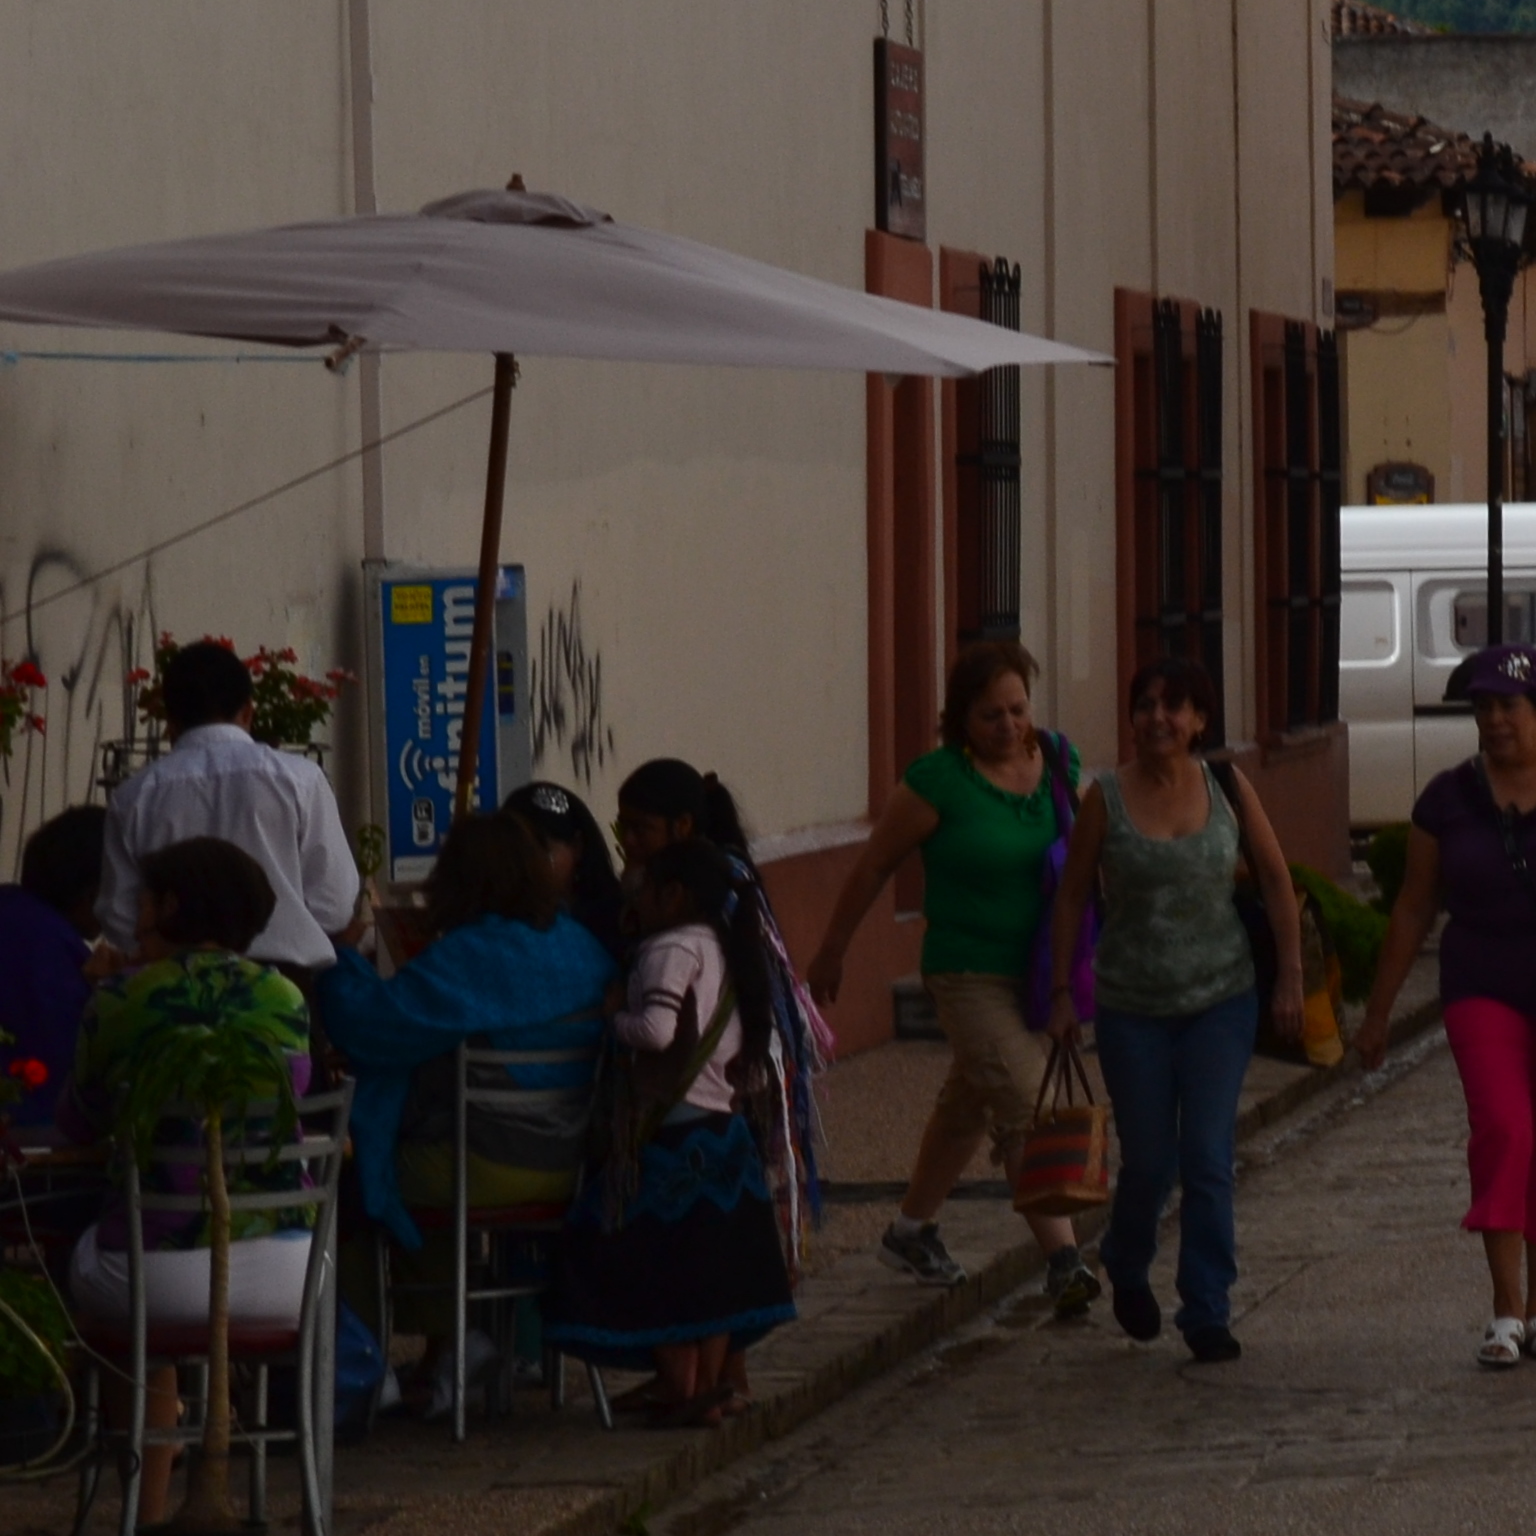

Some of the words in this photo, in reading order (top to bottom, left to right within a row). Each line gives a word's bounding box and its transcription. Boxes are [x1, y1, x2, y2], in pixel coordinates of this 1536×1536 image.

[419, 654, 430, 676] en
[413, 678, 431, 740] móvil
[433, 585, 480, 846] finitum
